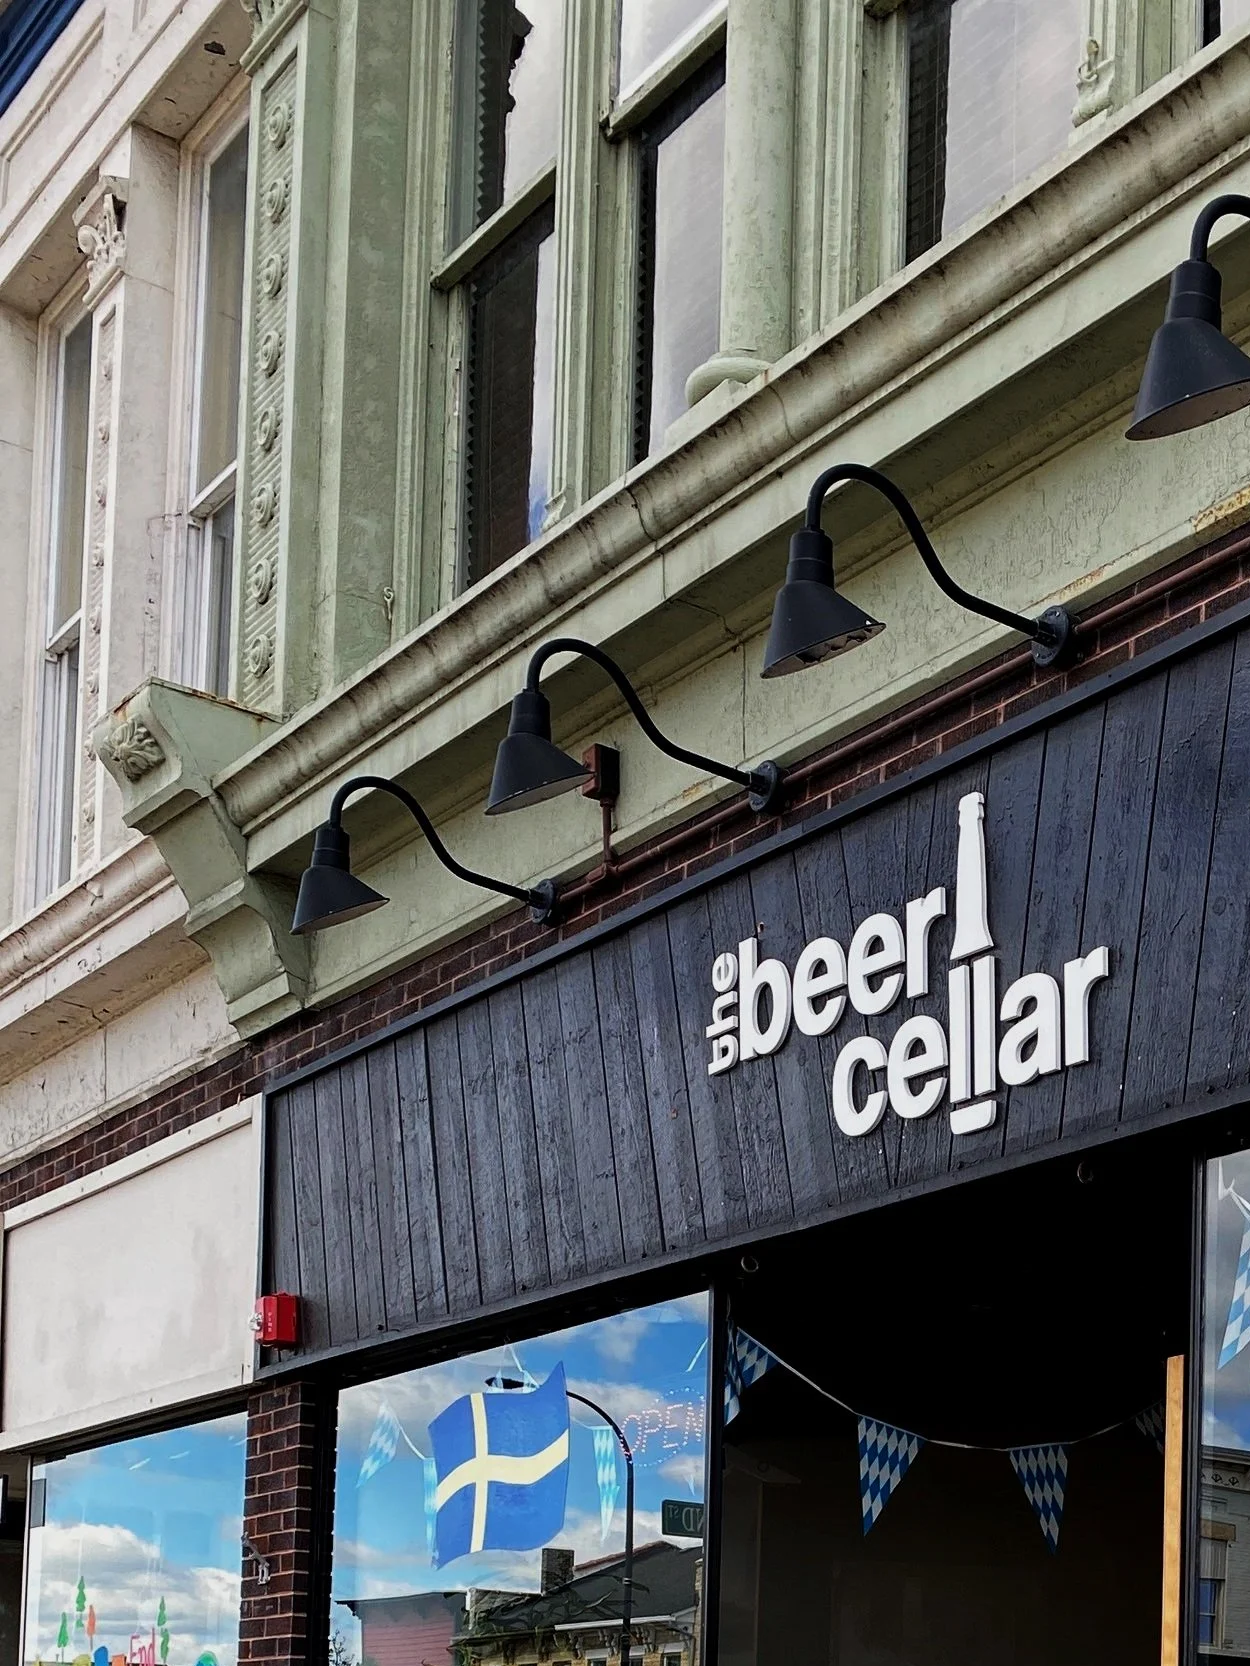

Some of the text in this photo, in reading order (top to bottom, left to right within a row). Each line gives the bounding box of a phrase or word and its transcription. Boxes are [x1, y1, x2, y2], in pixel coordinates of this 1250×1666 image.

[706, 952, 738, 1076] the
[739, 887, 946, 1062] beer
[832, 945, 1109, 1137] cellar
[620, 1400, 704, 1455] OPEN
